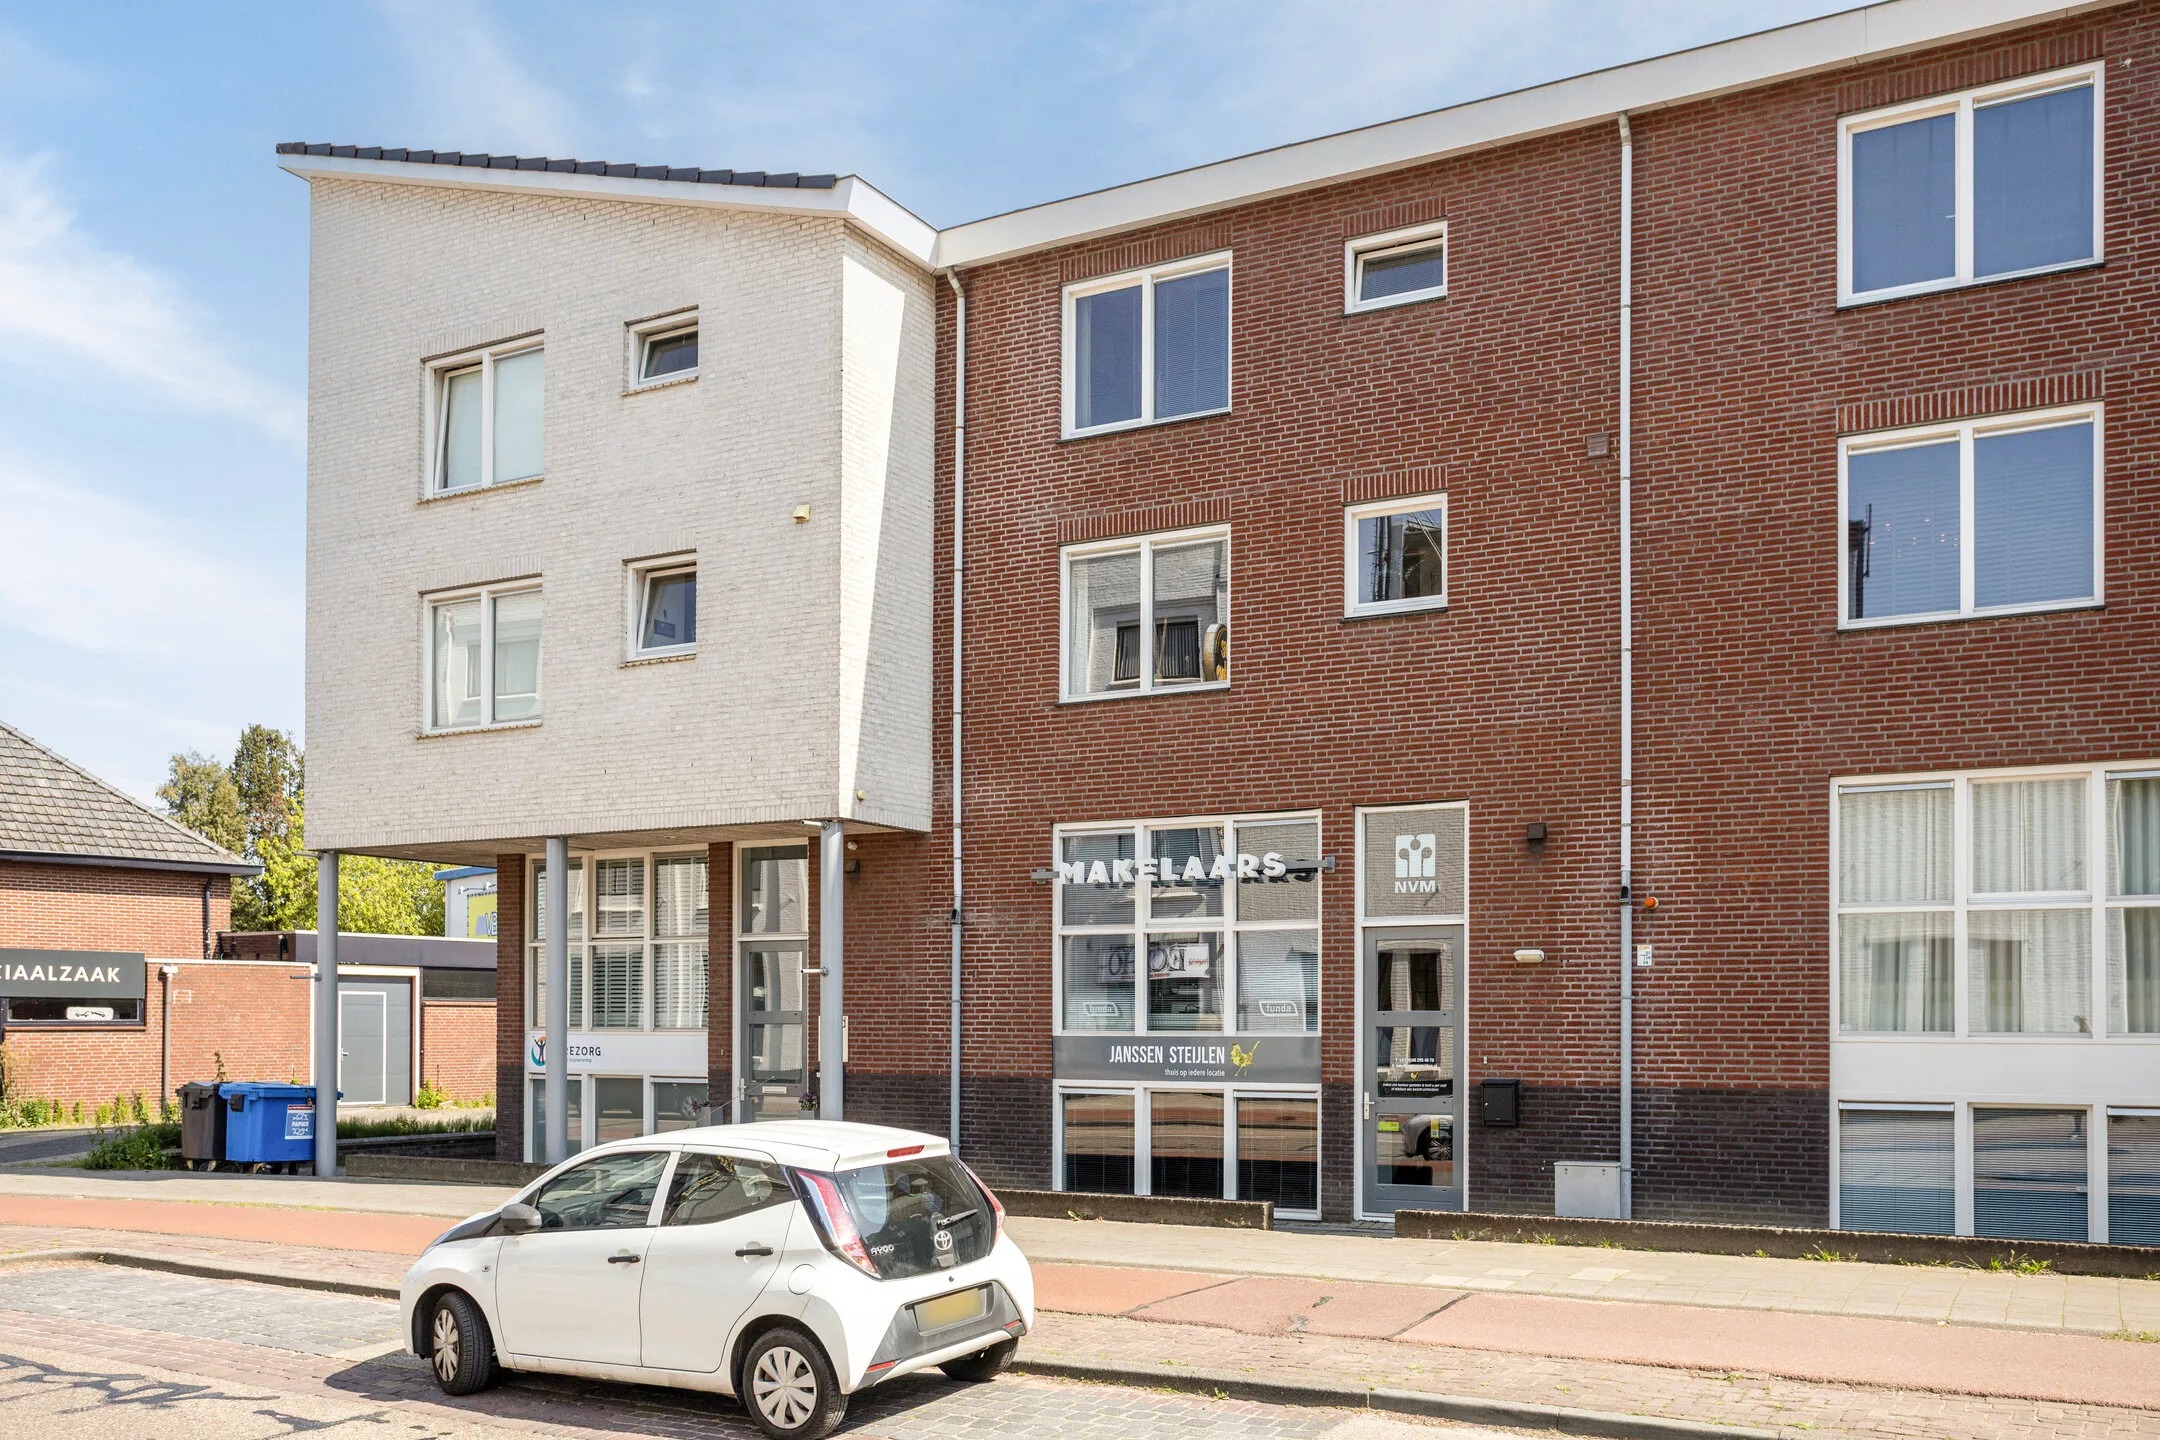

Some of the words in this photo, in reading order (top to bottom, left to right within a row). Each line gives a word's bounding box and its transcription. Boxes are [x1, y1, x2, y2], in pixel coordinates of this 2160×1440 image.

[1059, 851, 1286, 884] MAKELAARS
[1395, 880, 1436, 893] NVM
[0, 965, 120, 982] IAALZAAK
[566, 1046, 601, 1057] EZORG
[1109, 1045, 1163, 1063] JANSSEN
[1169, 1046, 1225, 1064] STEIJLEN
[1164, 1068, 1179, 1076] thuis
[1188, 1068, 1206, 1076] iedere
[1206, 1068, 1225, 1076] locatie
